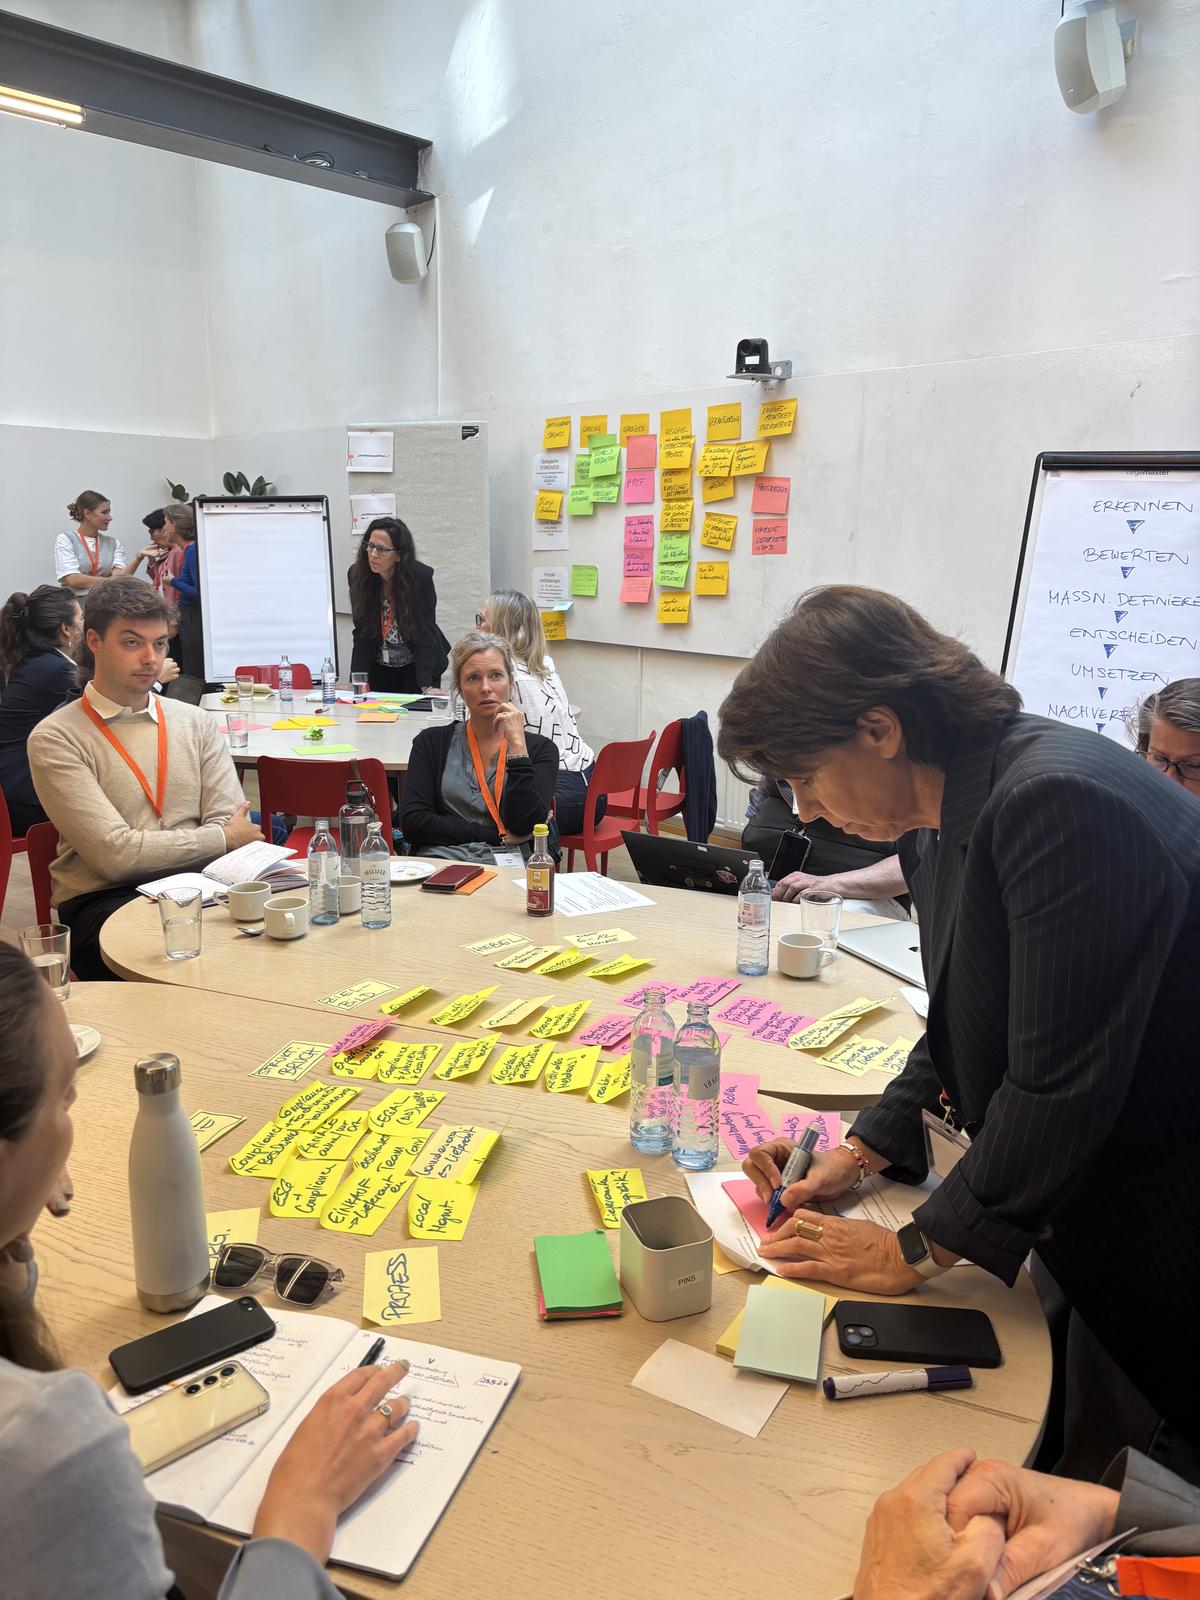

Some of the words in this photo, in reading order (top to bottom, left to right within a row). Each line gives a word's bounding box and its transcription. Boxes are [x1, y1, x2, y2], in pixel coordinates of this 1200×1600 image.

[1092, 500, 1194, 513] ERKENNEN
[1083, 547, 1189, 565] BEWERTEN
[1048, 590, 1112, 606] MASSN.
[1069, 628, 1198, 650] ENTSCHEIDEN
[1071, 663, 1170, 686] UMSETZEN
[277, 1047, 321, 1076] BRUCH
[376, 1145, 405, 1173] Team
[327, 1177, 372, 1224] EINKAUF
[677, 1274, 697, 1287] PINS
